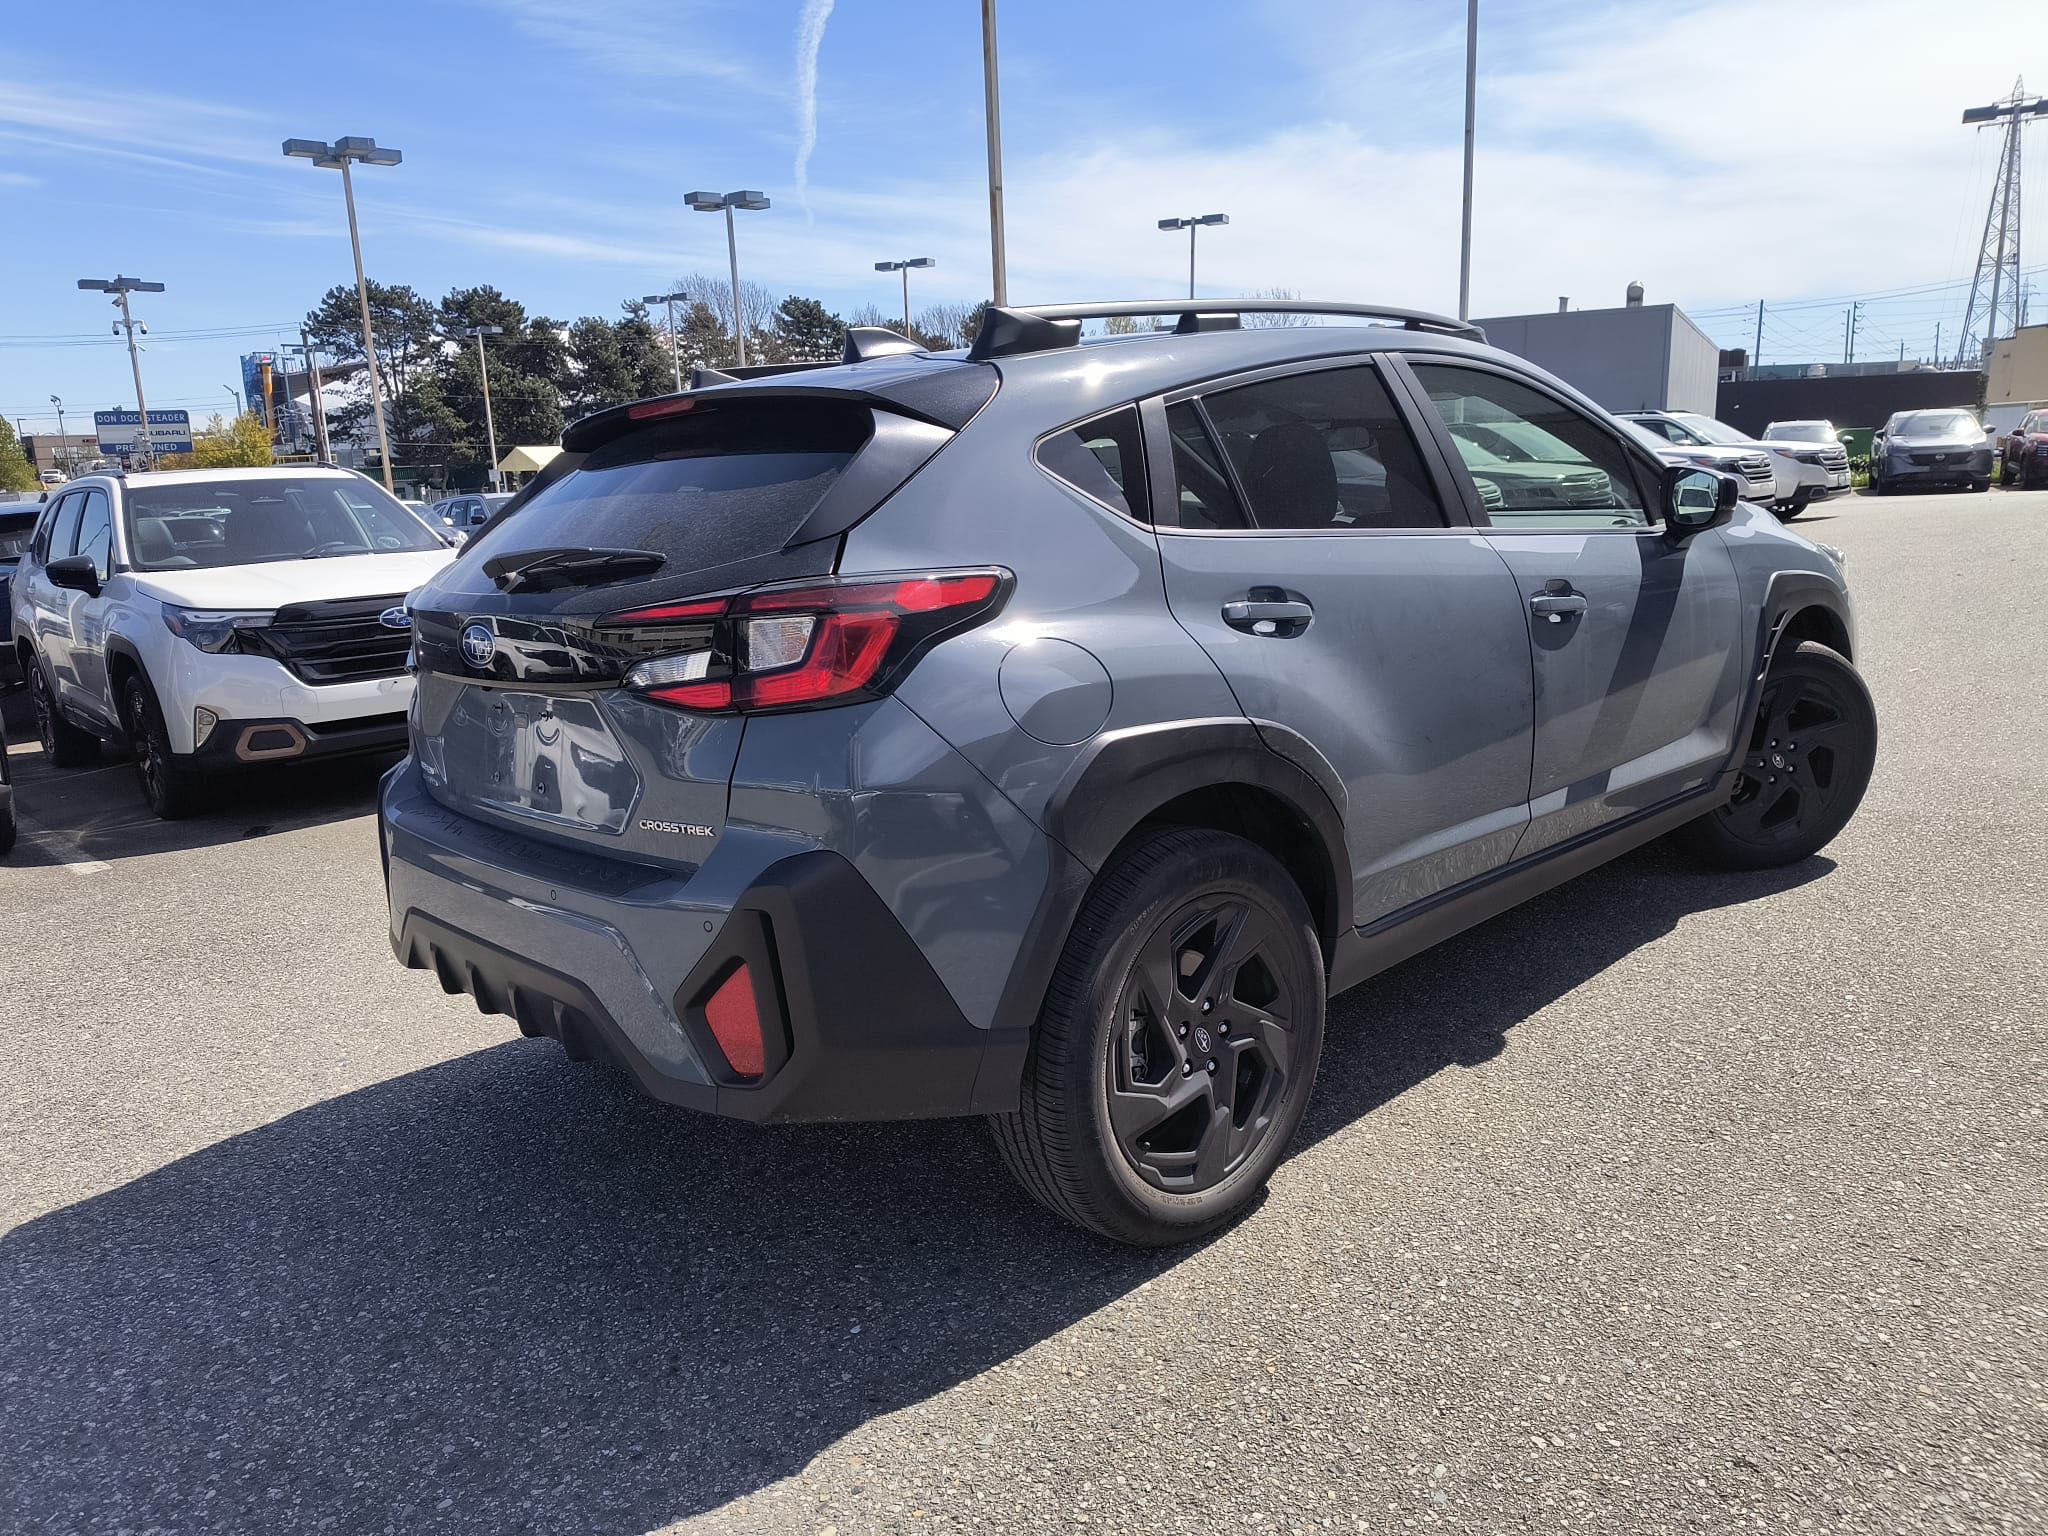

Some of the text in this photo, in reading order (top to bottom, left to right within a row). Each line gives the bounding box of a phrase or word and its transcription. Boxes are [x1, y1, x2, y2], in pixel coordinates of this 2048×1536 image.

[97, 413, 185, 423] DON DOCSTEADER
[639, 819, 715, 837] CROSSTREK
